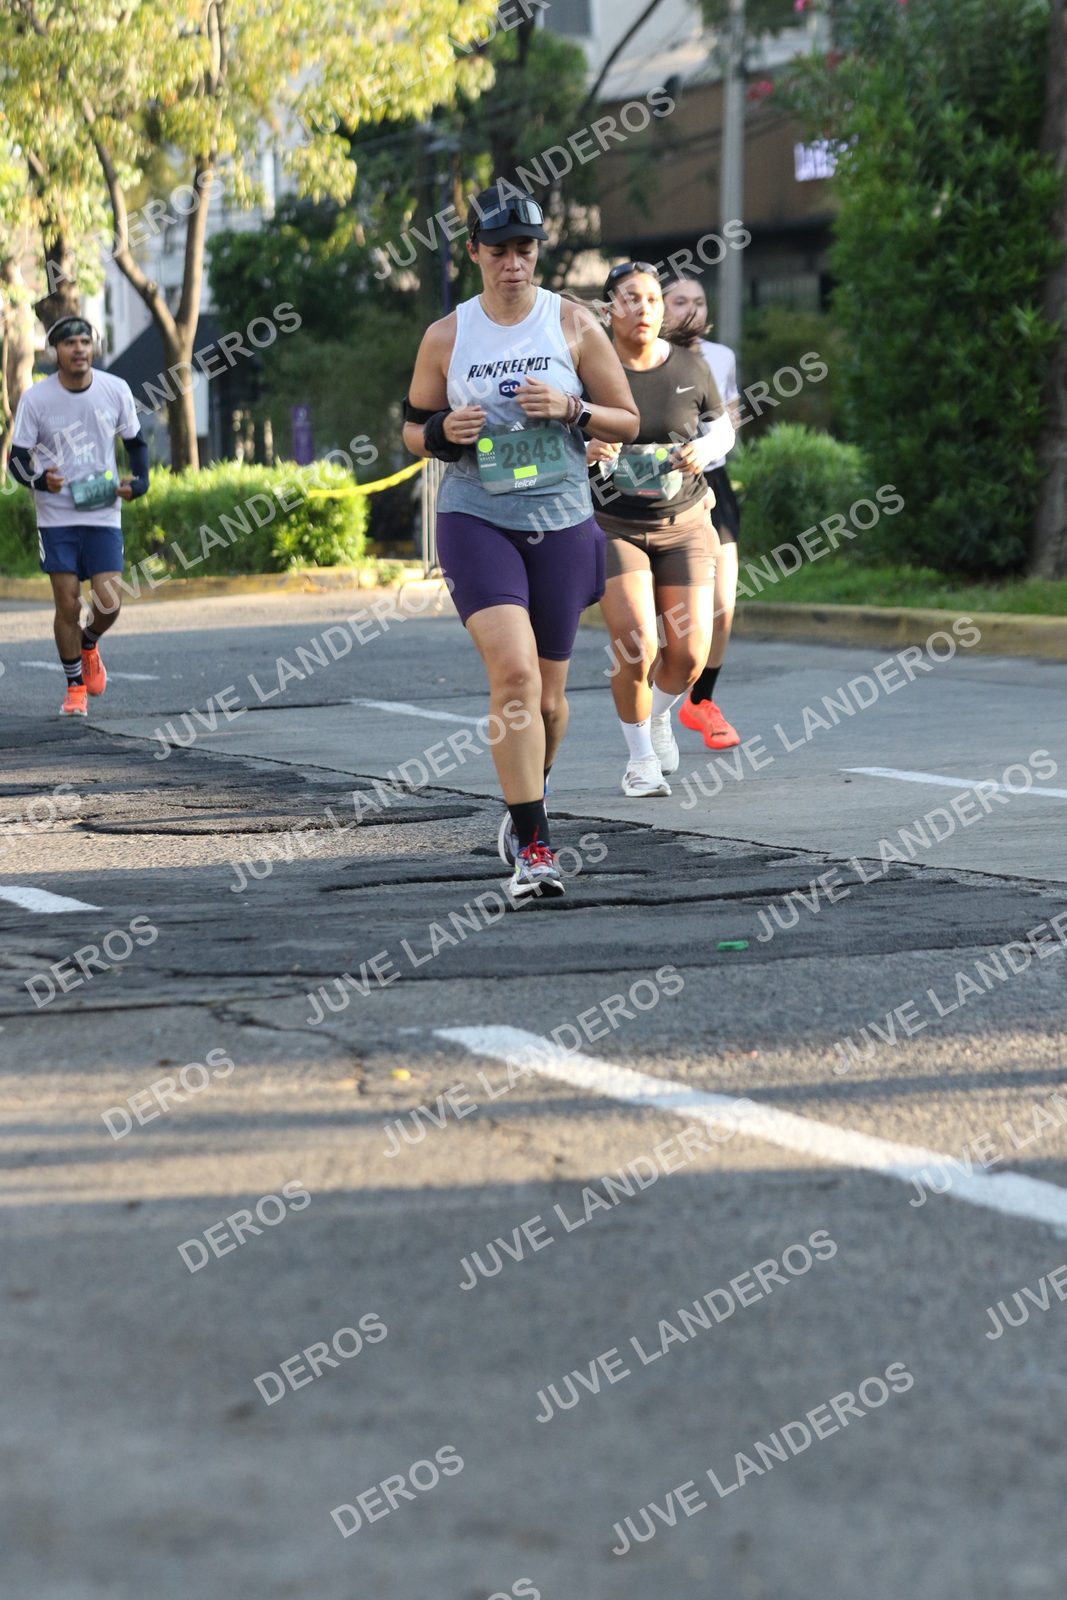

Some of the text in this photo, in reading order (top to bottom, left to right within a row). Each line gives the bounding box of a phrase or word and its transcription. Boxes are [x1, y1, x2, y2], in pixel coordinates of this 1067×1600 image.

[501, 384, 518, 393] GU
[500, 435, 561, 469] 2843
[514, 478, 537, 488] telcel
